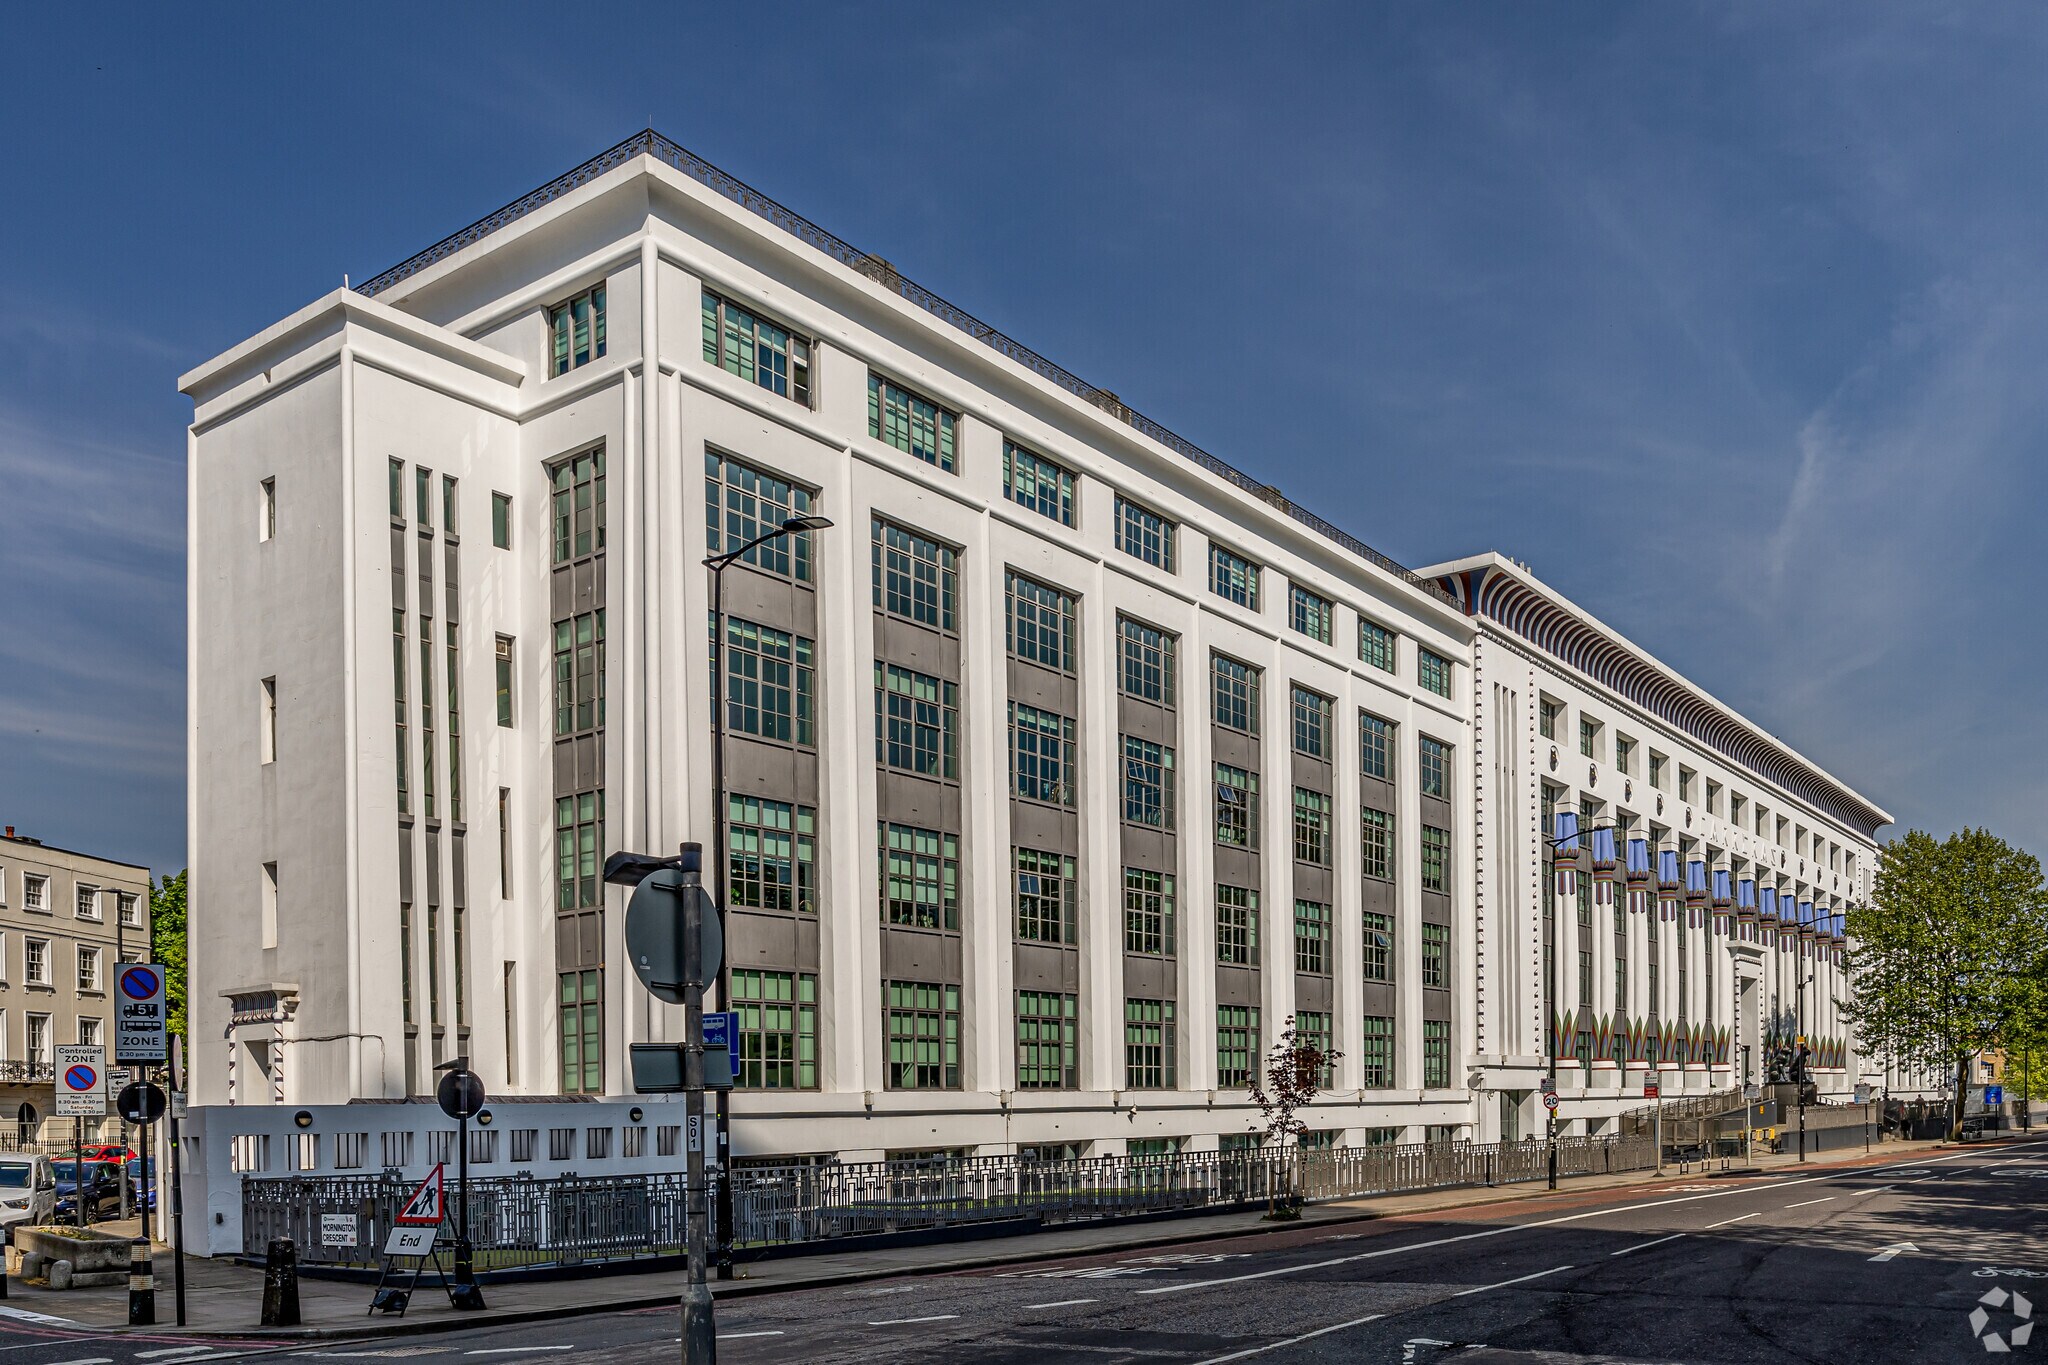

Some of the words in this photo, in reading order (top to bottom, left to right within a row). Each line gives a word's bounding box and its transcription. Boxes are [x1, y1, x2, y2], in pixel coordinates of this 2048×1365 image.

[122, 1036, 160, 1046] ZONE
[65, 1055, 96, 1063] ZONE
[1546, 1097, 1557, 1105] 20
[322, 1223, 356, 1232] MORNINGTON
[322, 1233, 348, 1242] CRESCENT
[399, 1234, 422, 1247] End
